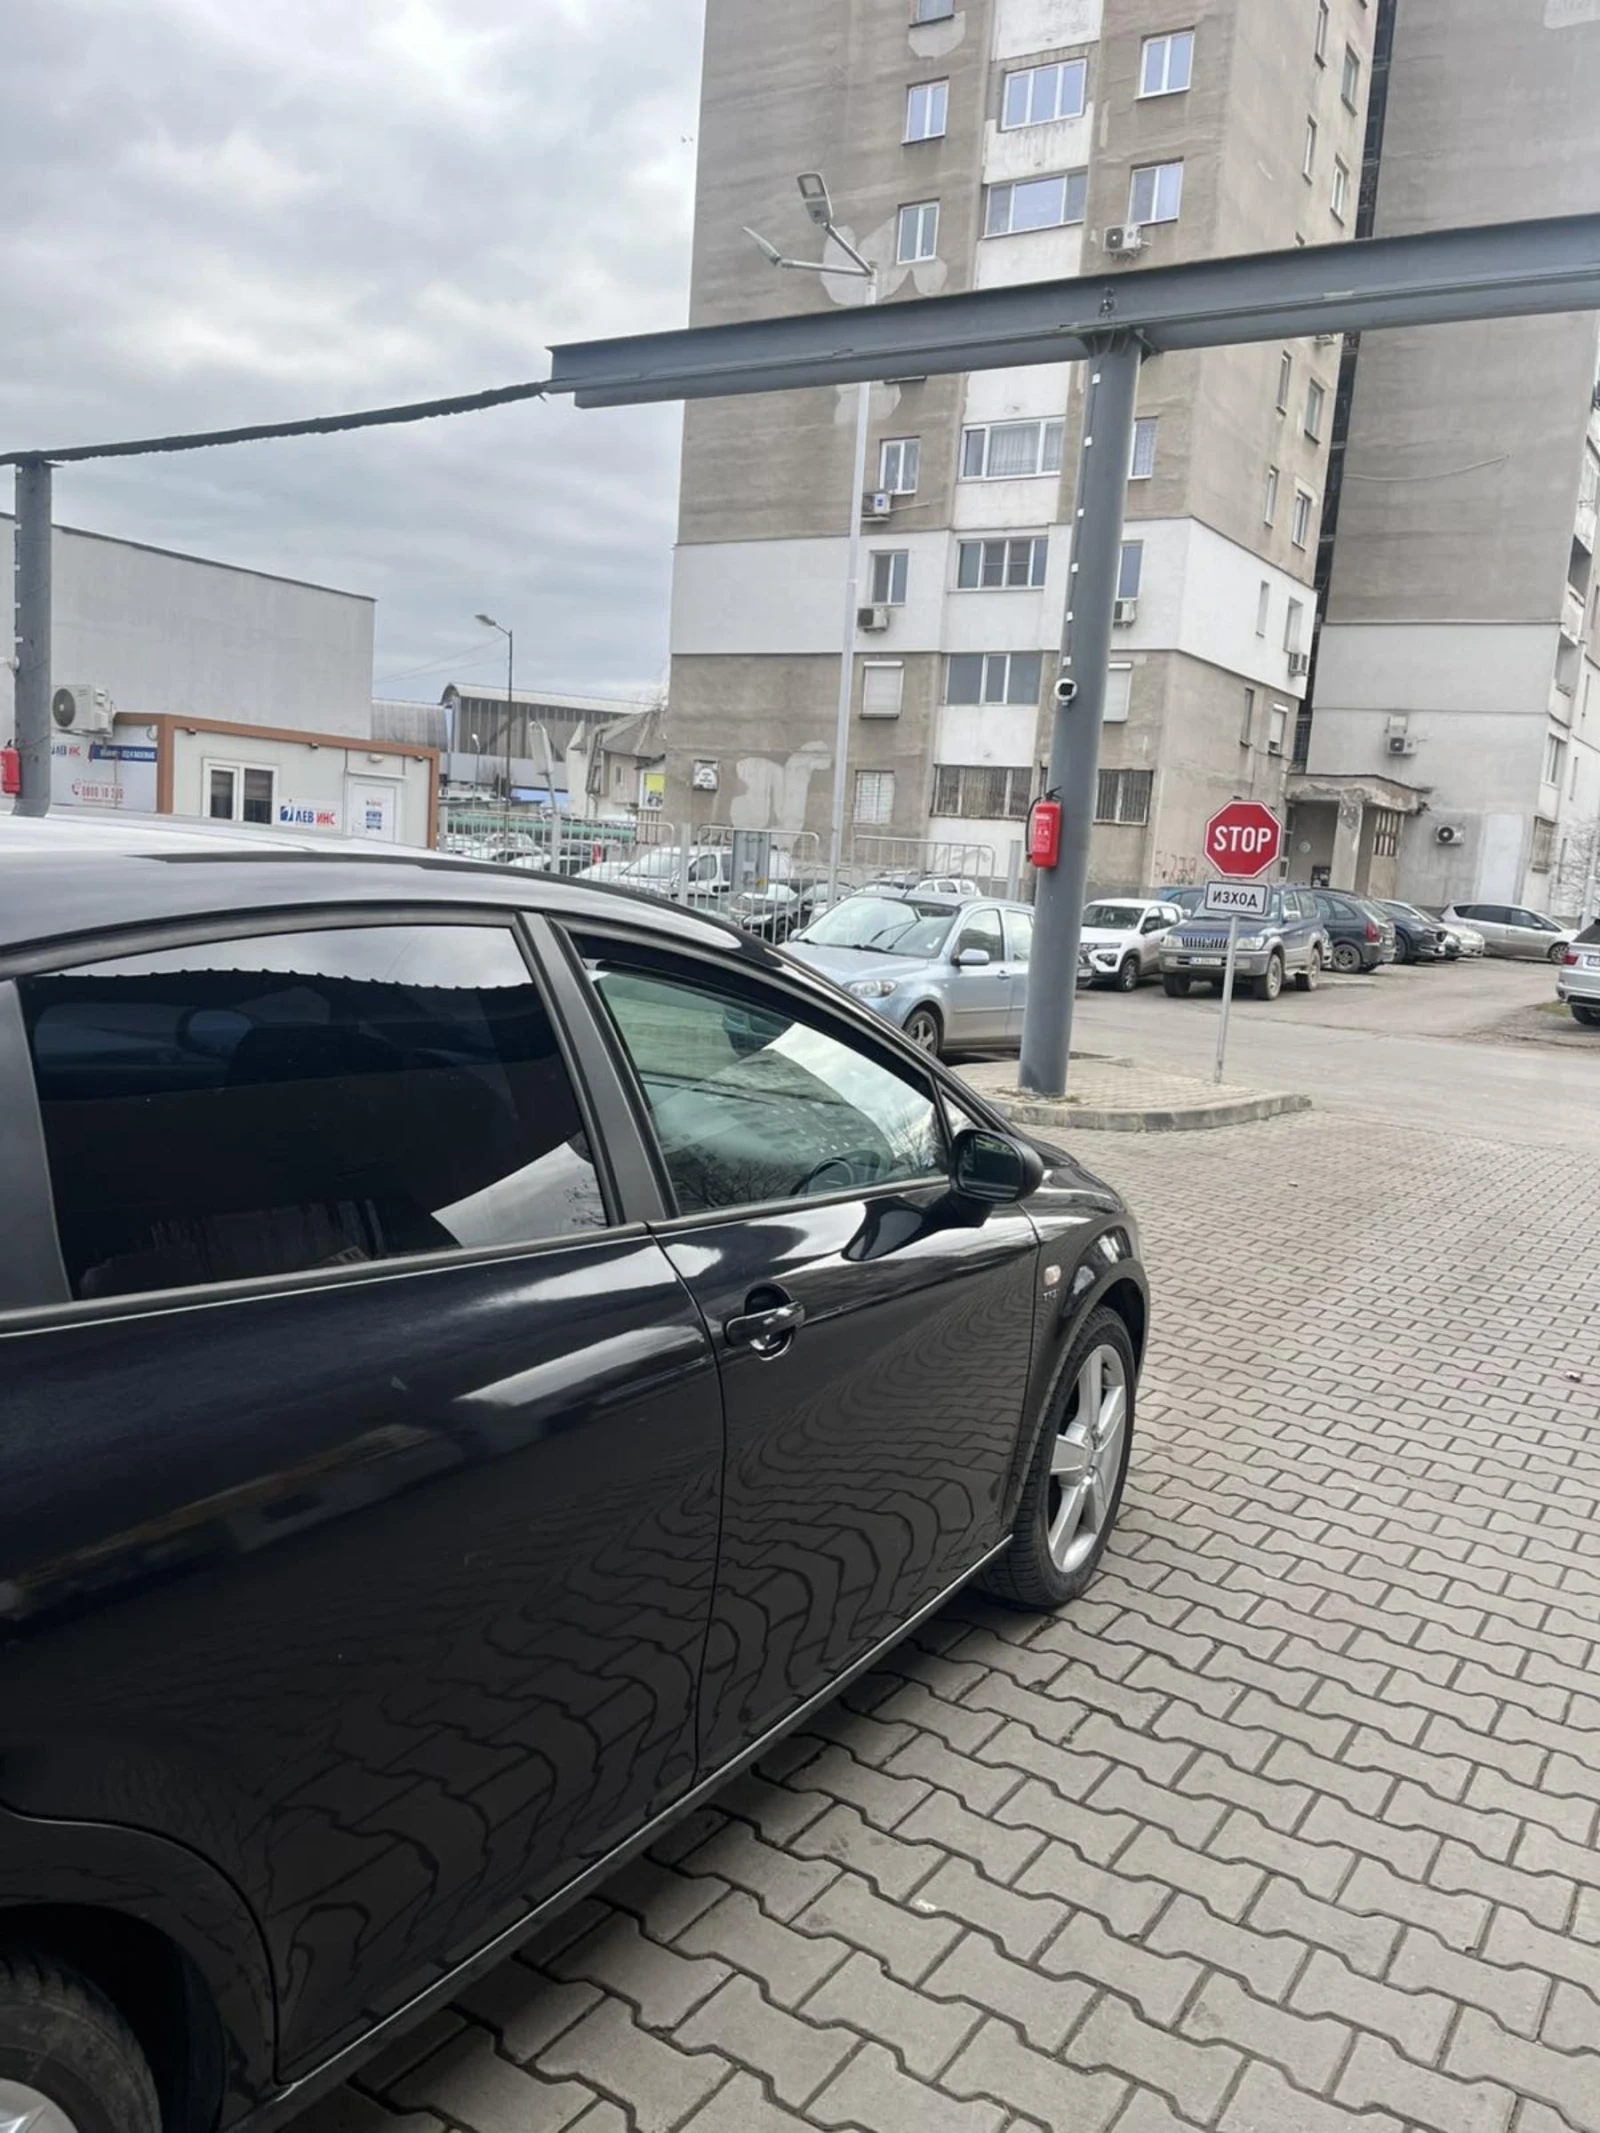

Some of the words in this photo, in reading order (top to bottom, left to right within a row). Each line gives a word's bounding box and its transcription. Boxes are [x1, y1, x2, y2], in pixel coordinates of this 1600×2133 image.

[295, 810, 314, 824] ЛЕВ
[316, 812, 335, 825] ИНС
[1213, 825, 1272, 853] STOP
[1213, 890, 1258, 908] ИЗХОД
